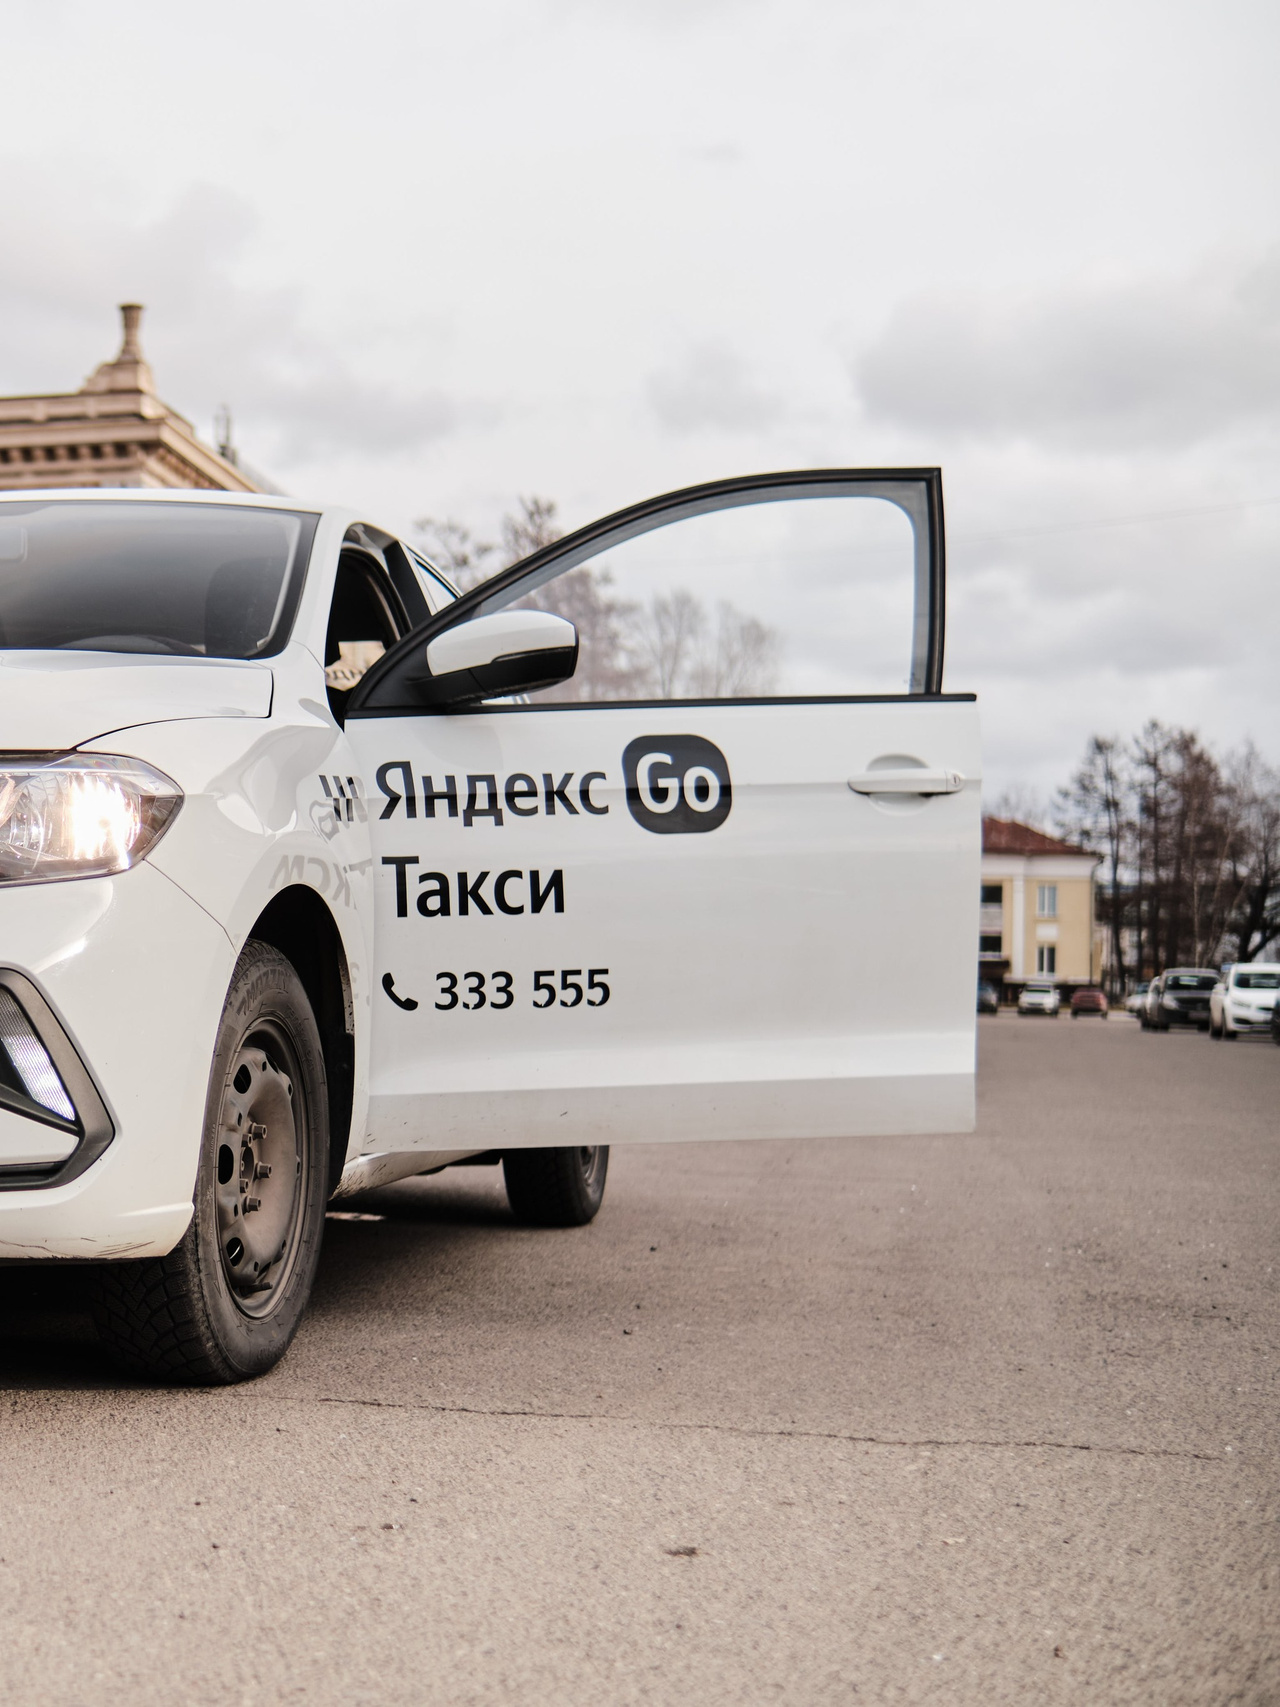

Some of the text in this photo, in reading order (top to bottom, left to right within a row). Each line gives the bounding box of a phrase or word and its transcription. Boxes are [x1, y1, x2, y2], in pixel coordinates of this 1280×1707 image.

[375, 760, 611, 828] Яндекс
[634, 751, 721, 815] Go
[381, 855, 566, 919] Такси
[434, 968, 611, 1011] 333 555
